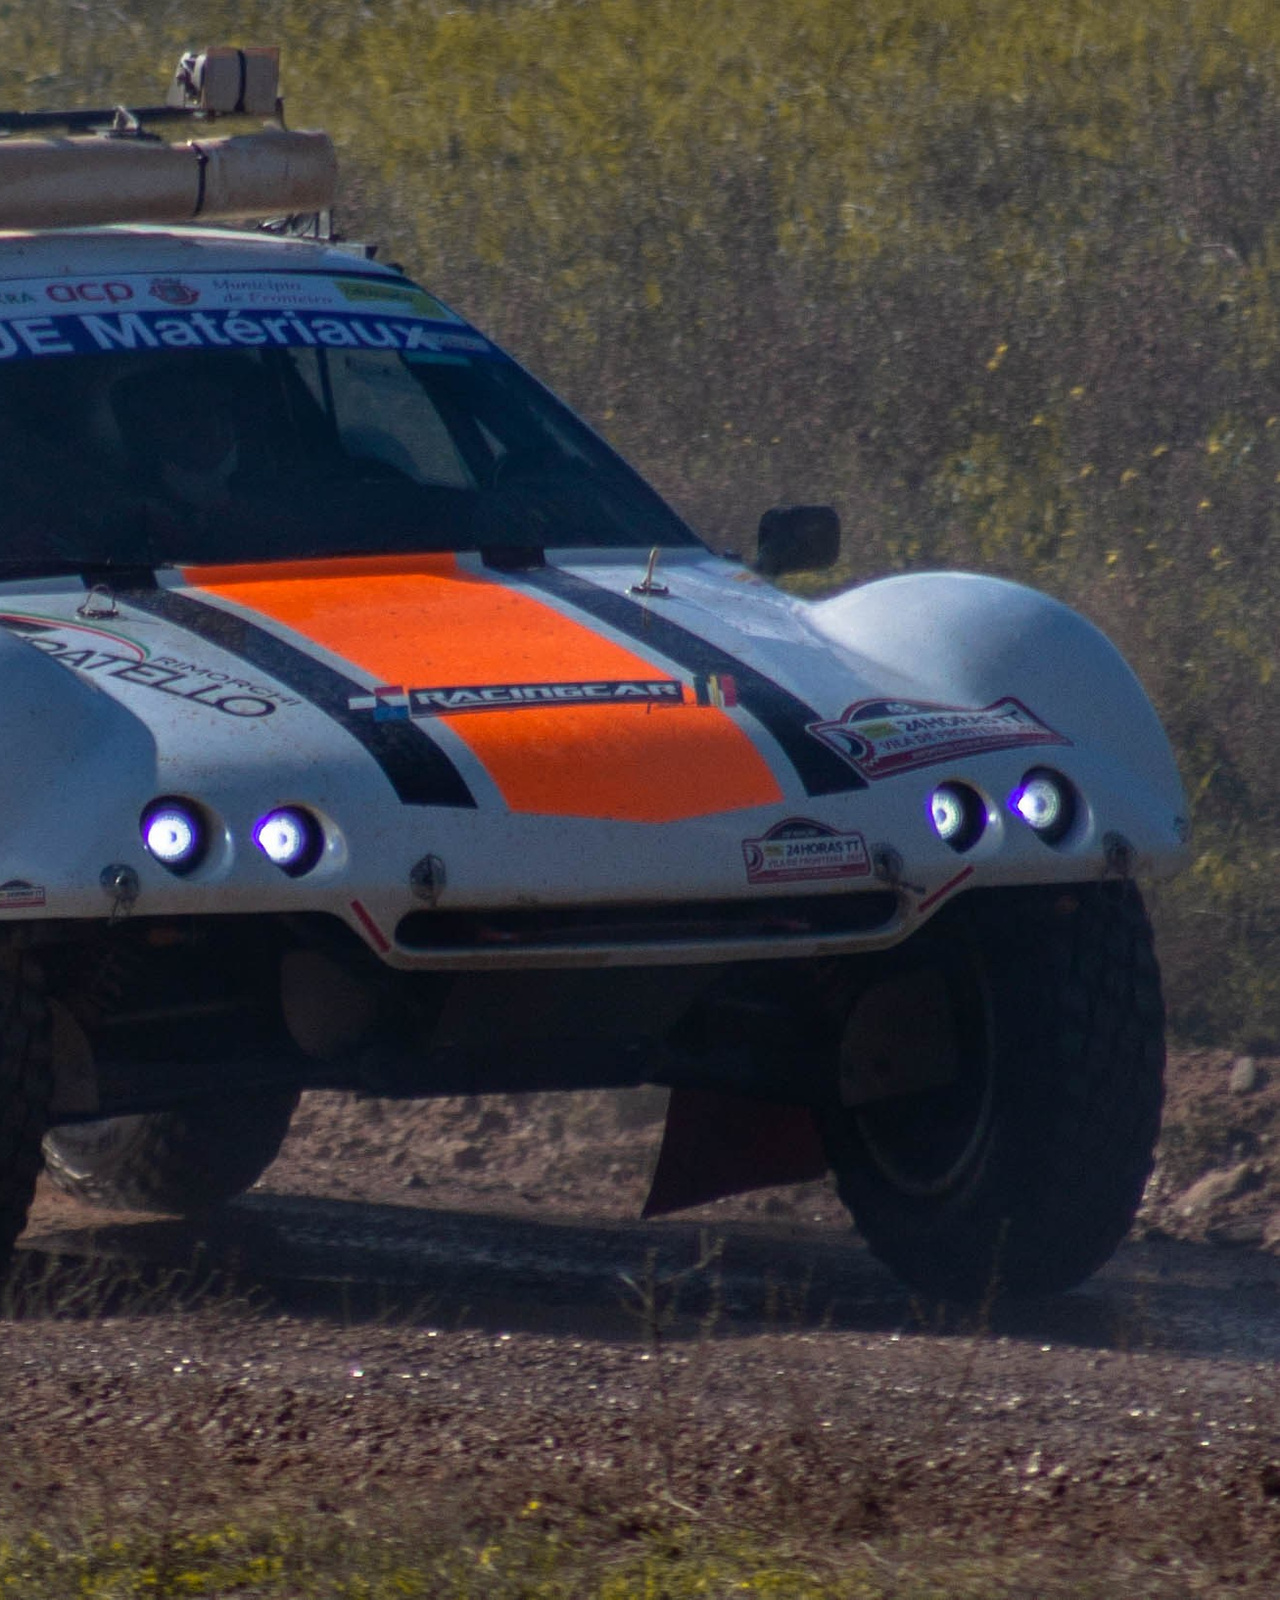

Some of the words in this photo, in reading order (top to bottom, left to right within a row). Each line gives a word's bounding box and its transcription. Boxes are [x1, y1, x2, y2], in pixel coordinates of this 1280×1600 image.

[45, 281, 135, 304] acp
[78, 309, 442, 353] Matériaux
[152, 655, 302, 707] RIMORCHI
[416, 683, 679, 709] RACINGCAR
